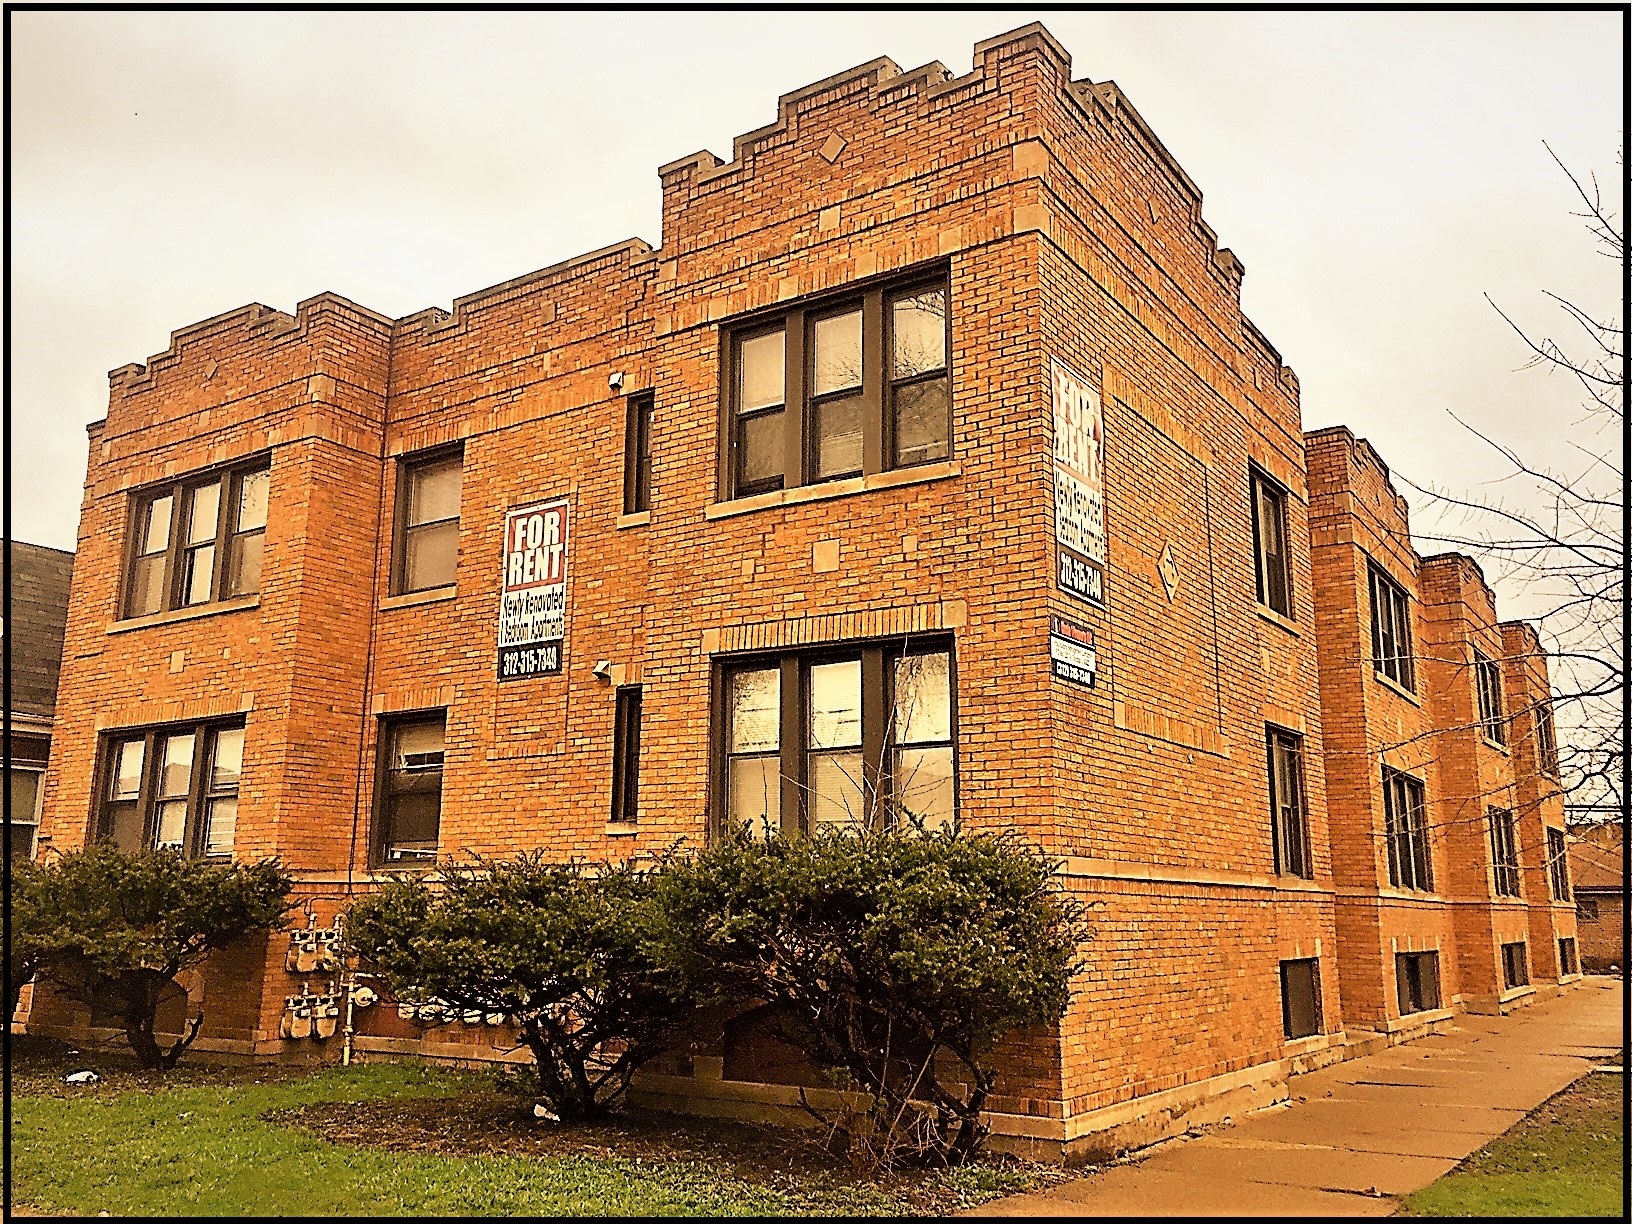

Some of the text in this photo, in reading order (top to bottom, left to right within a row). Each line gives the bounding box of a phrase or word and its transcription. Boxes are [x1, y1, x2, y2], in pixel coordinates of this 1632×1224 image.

[1055, 371, 1095, 437] FOR
[1056, 415, 1100, 481] RENT
[514, 510, 561, 552] FOR
[508, 543, 564, 587] RENT
[502, 585, 564, 623] Newly Renovated
[503, 646, 557, 676] 312-315-7340
